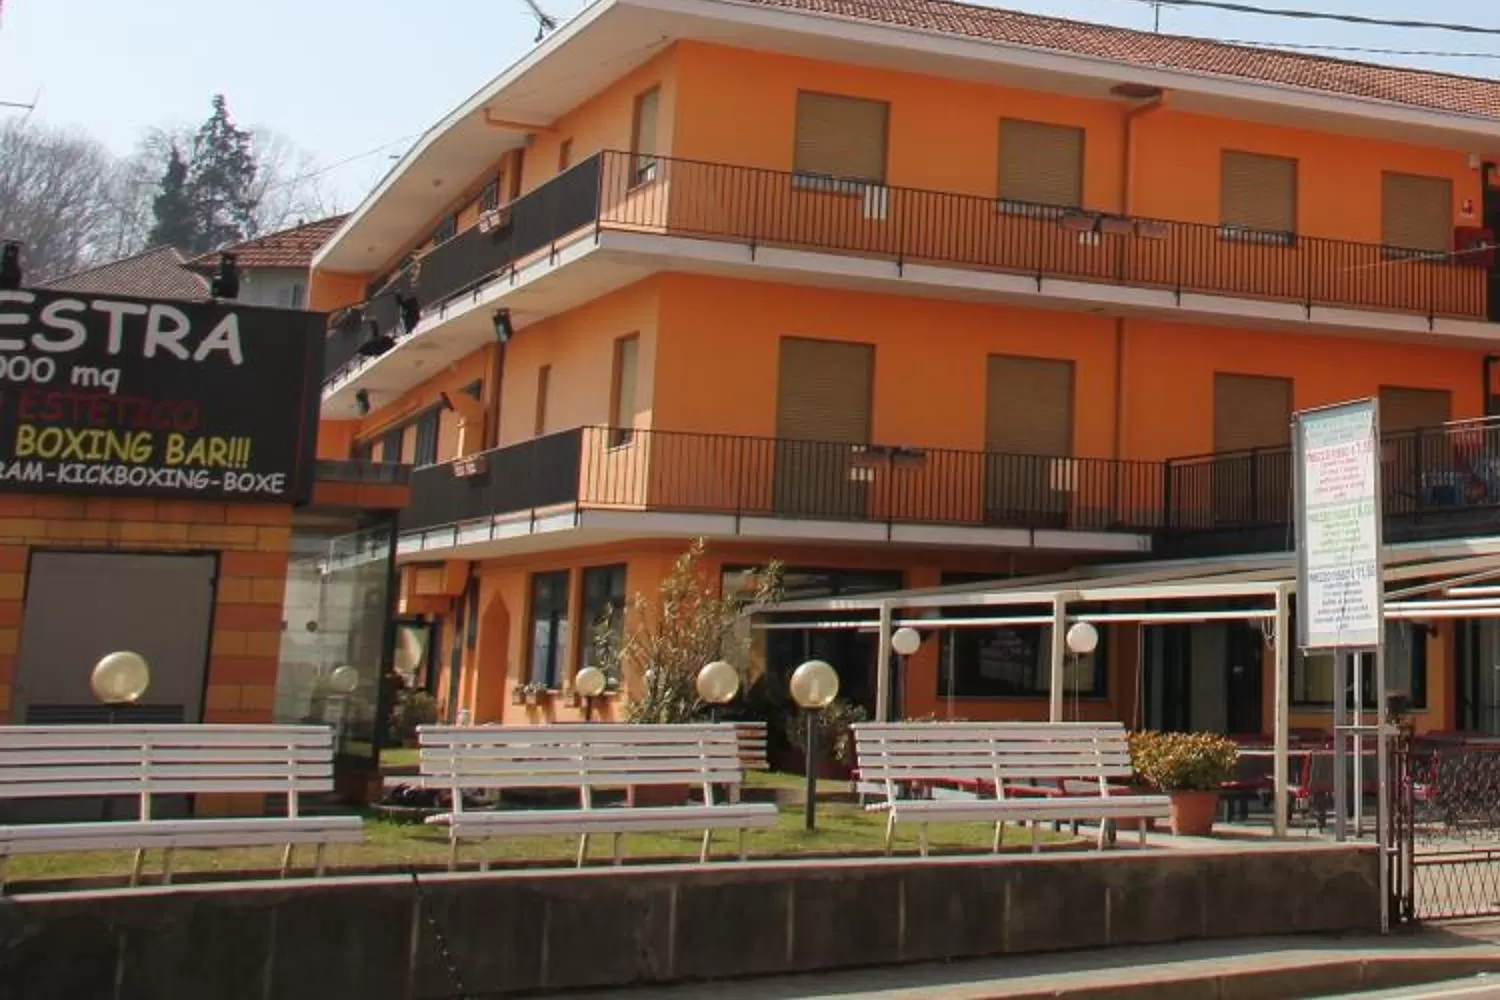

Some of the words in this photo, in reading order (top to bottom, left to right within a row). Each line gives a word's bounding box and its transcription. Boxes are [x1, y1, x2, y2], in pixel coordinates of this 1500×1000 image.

[71, 365, 121, 395] mq
[15, 425, 152, 464] BOXING
[165, 433, 250, 468] BAR!!!
